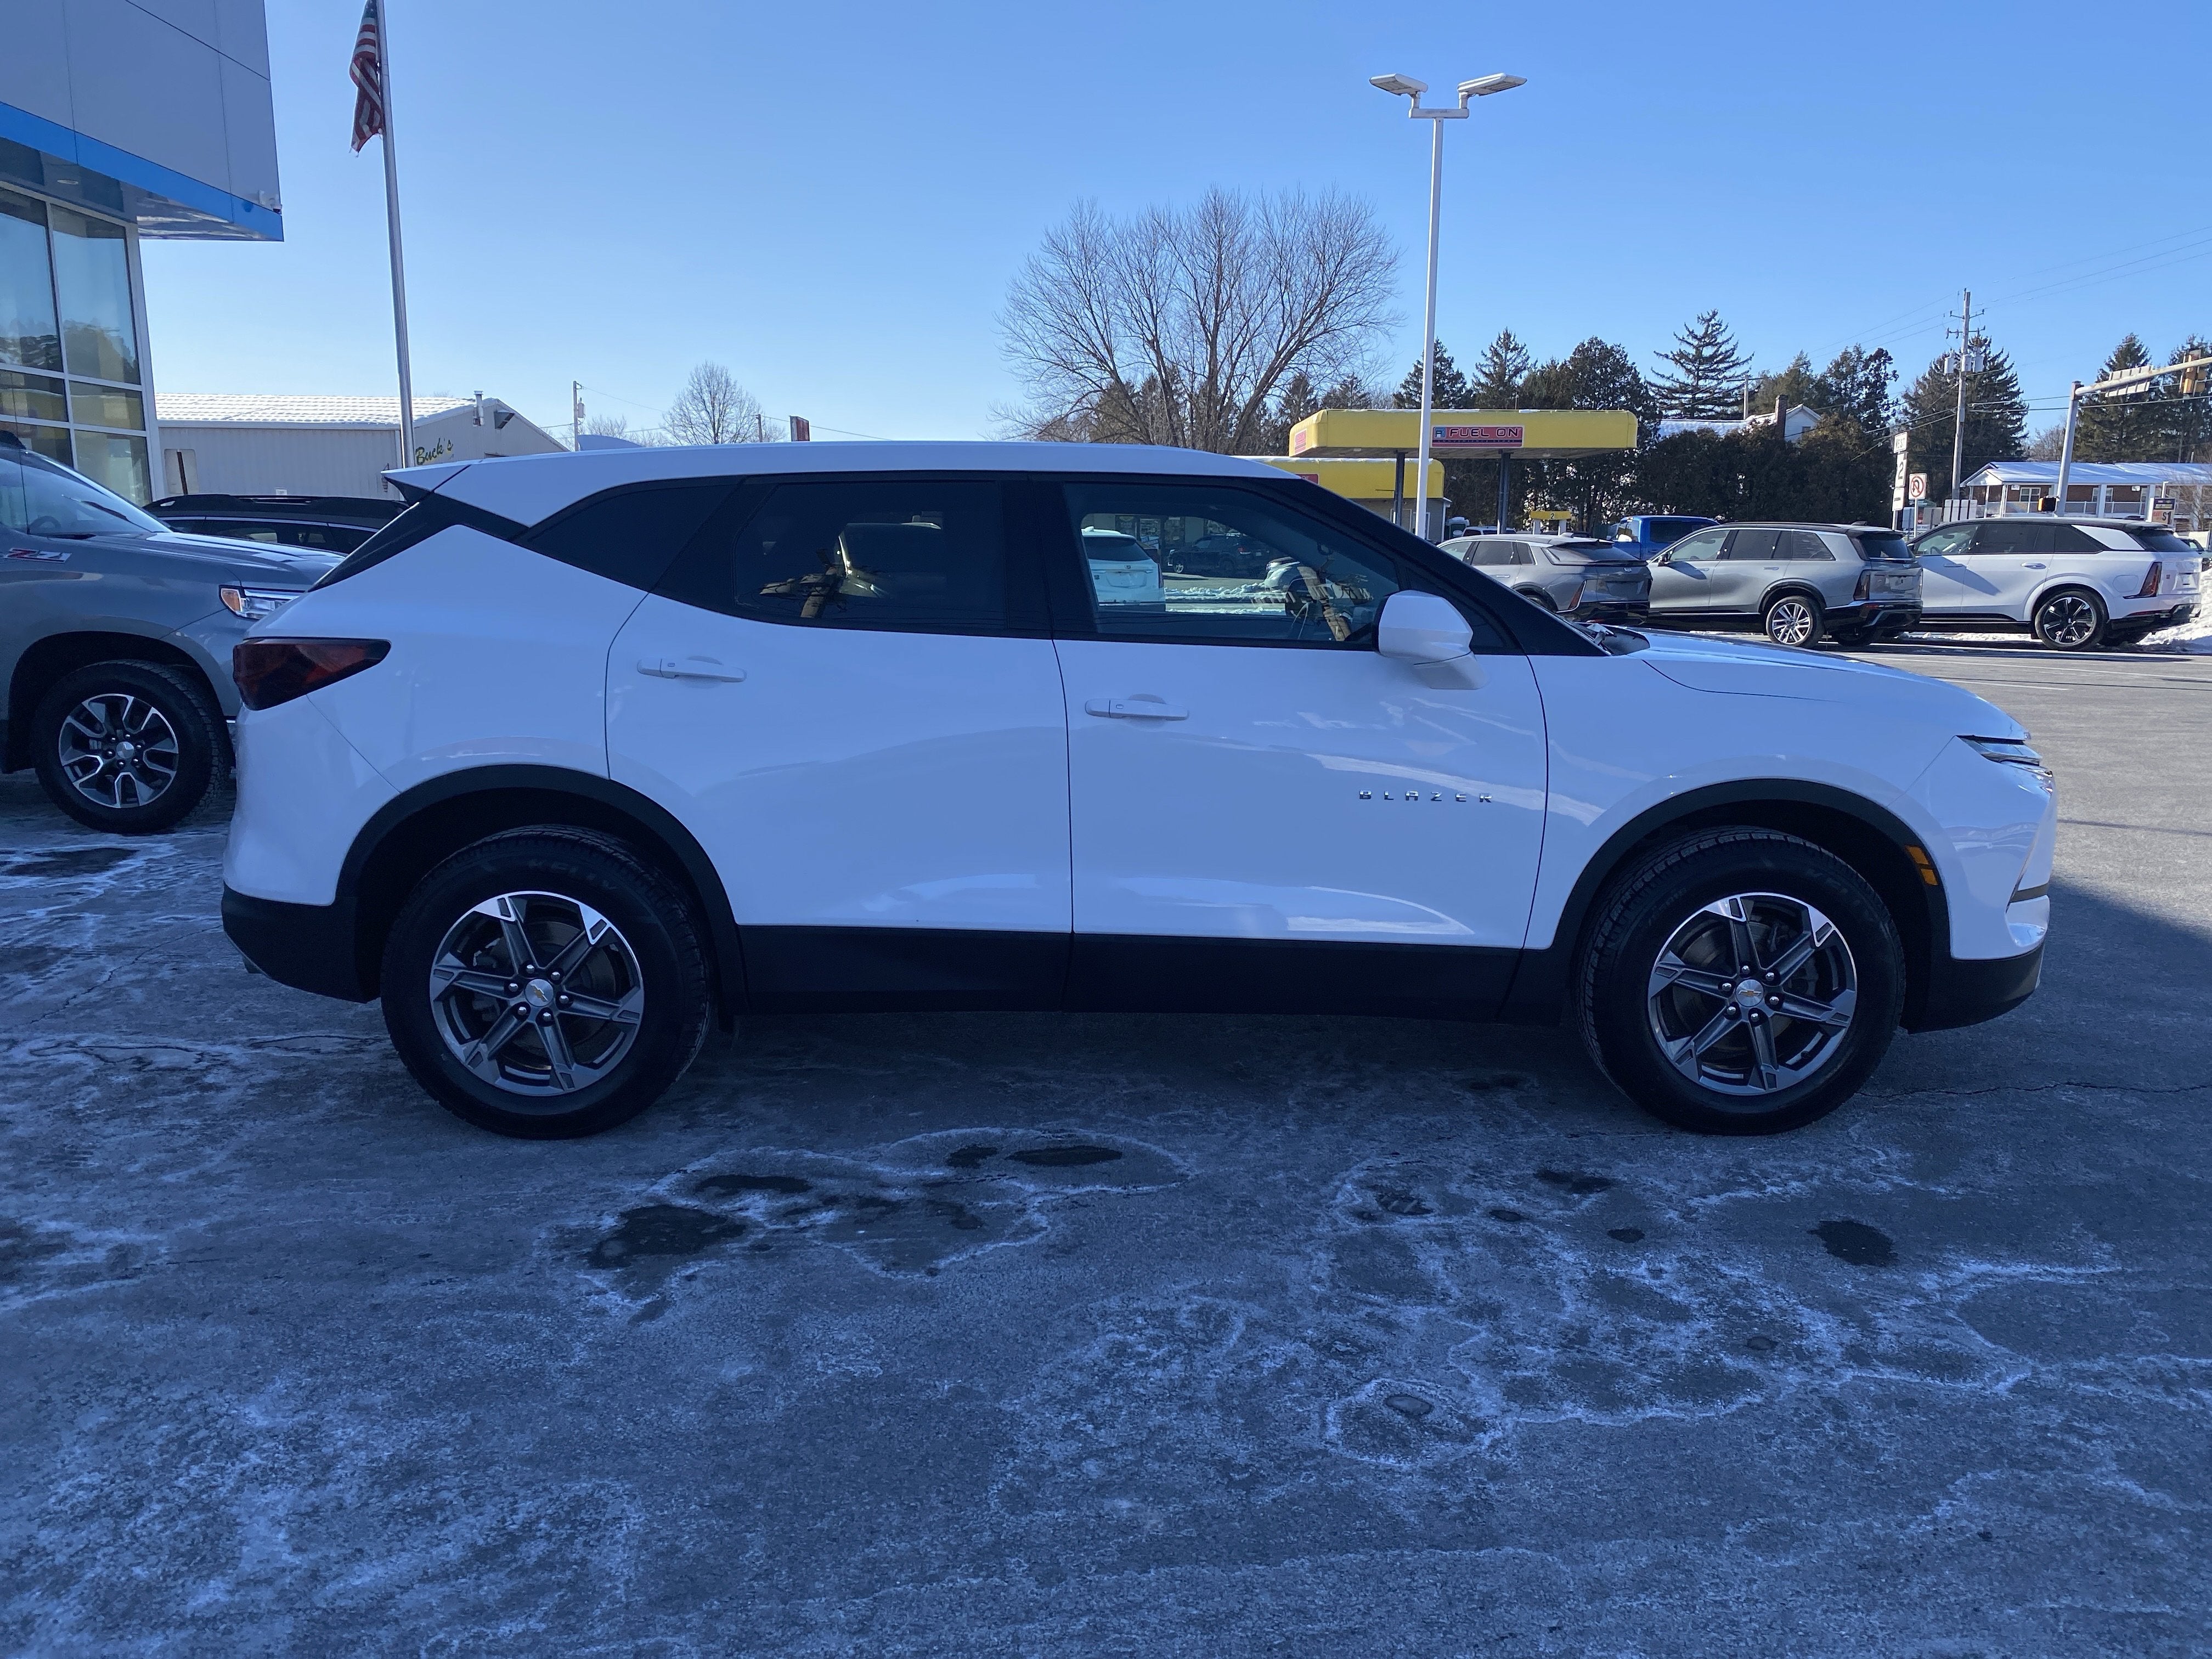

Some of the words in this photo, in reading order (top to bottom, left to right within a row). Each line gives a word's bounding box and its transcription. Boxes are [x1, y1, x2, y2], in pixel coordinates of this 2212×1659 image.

[1449, 427, 1490, 438] FUEL
[1496, 427, 1520, 438] ON
[415, 437, 454, 465] Buck's
[1359, 789, 1492, 803] BLAZER
